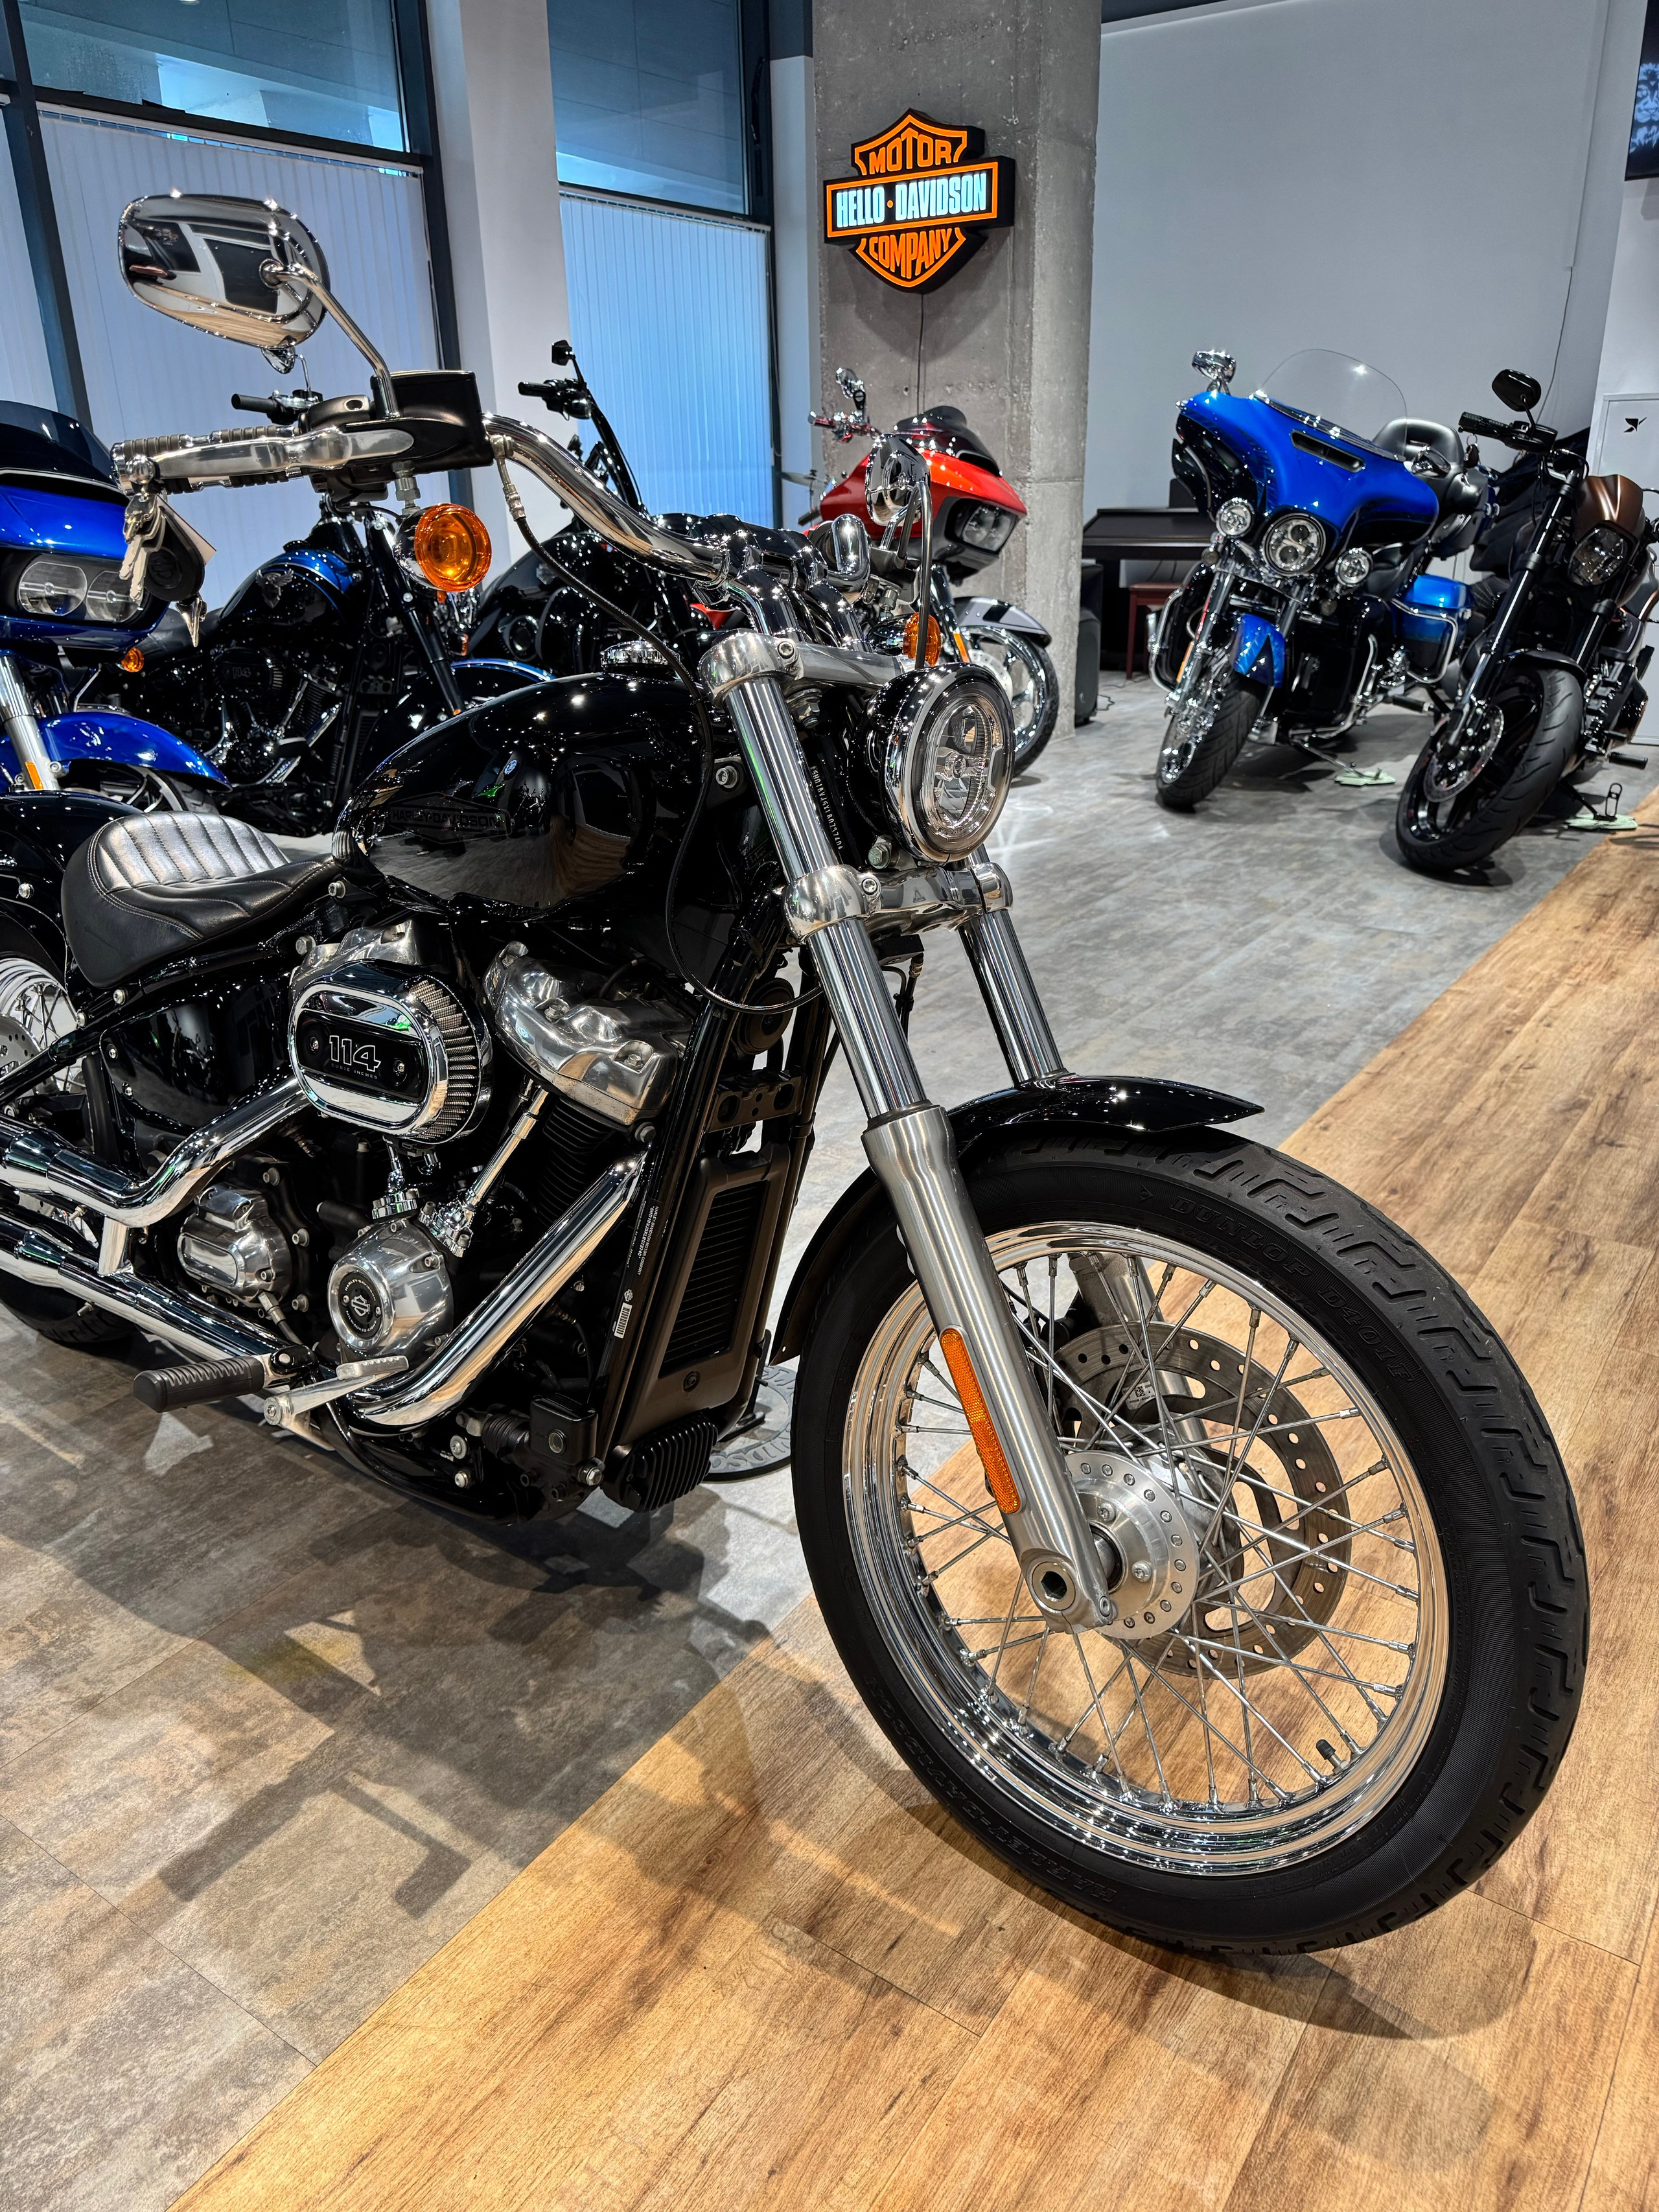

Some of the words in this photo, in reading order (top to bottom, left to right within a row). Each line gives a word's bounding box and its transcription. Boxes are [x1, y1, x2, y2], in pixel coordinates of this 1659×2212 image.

[869, 127, 951, 174] MOTOR
[837, 186, 885, 228] HELLO
[895, 172, 987, 221] DAVIDSON
[869, 228, 953, 279] COMPANY
[329, 1035, 382, 1073] 114
[331, 1063, 351, 1072] CUBIC
[354, 1069, 378, 1080] INCHES
[636, 1256, 646, 1276] COMPANY
[642, 1240, 650, 1257] MOTOR
[1169, 1196, 1312, 1277] DUNLOP
[1317, 1286, 1416, 1382] D401F
[864, 1673, 1117, 1903] HARLEY-DAVIDSON
